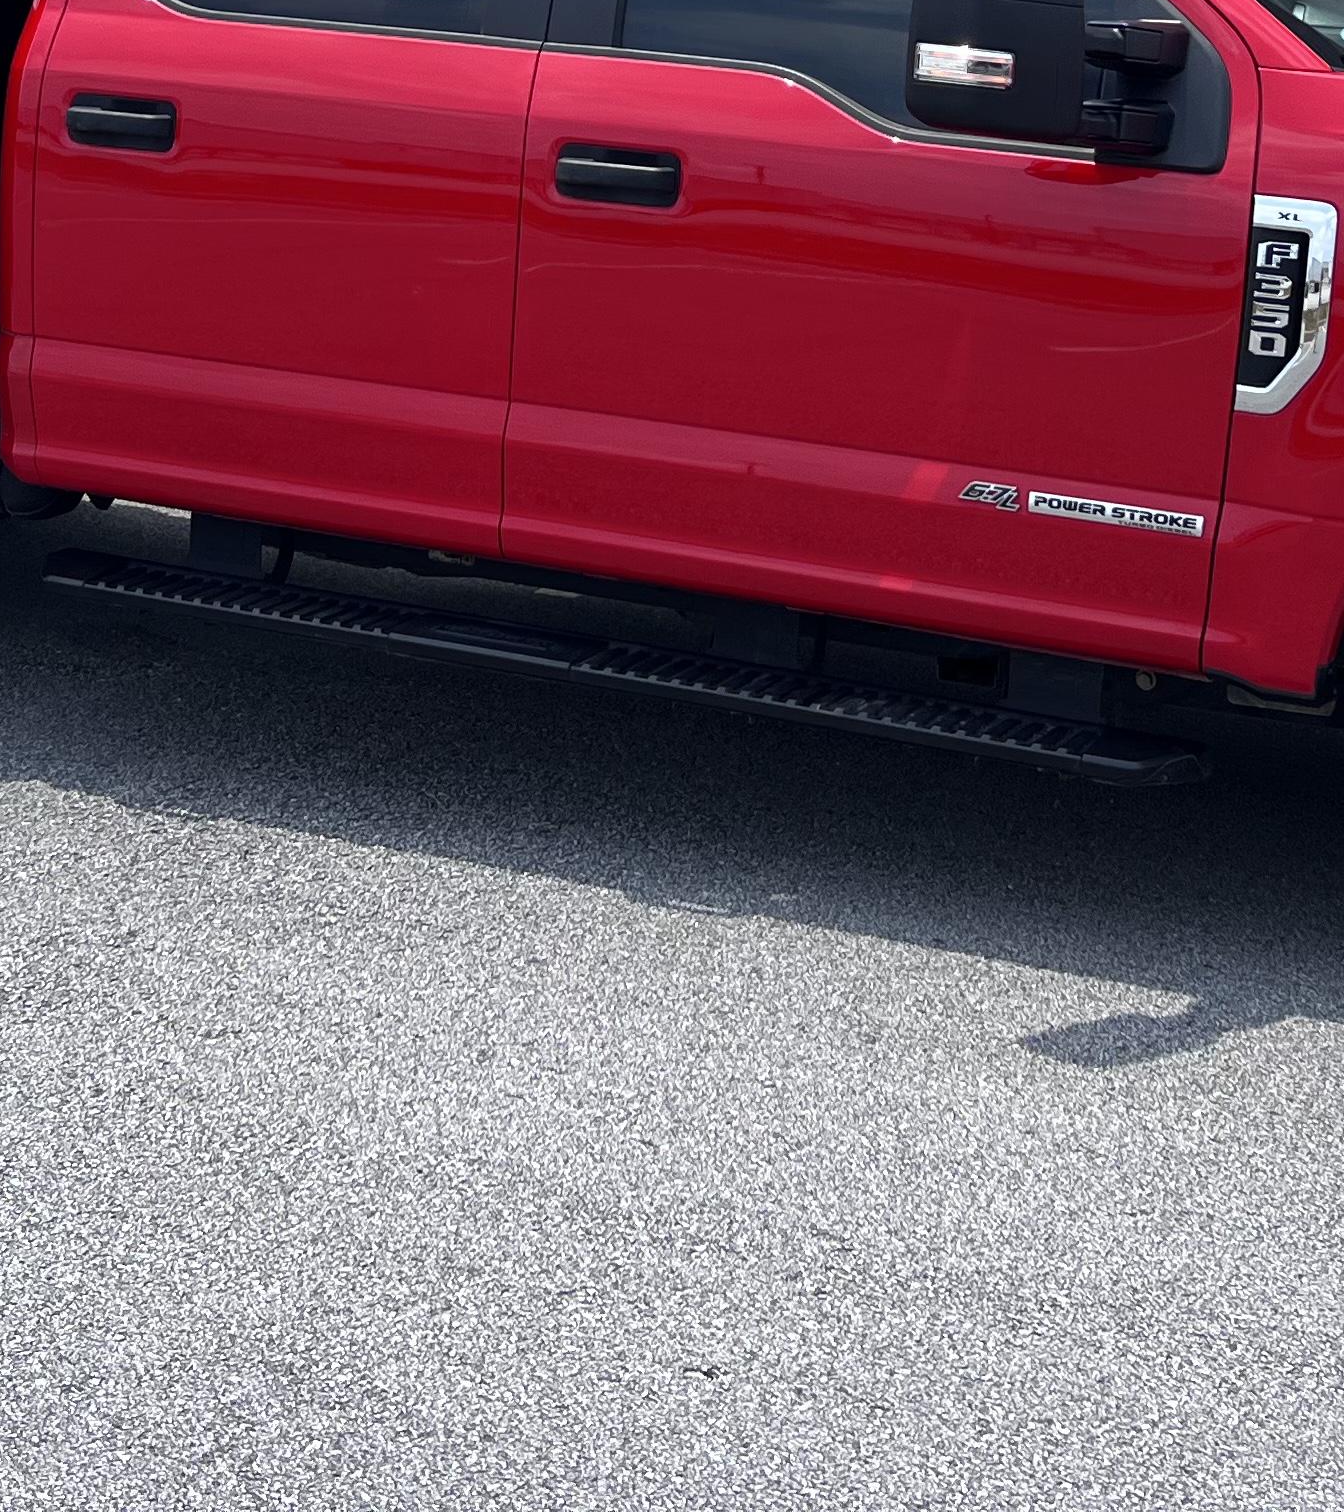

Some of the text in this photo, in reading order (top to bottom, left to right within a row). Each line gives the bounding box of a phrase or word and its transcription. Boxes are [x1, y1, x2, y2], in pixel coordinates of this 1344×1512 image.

[1277, 211, 1303, 222] XL
[1248, 240, 1299, 358] F350
[1034, 495, 1106, 516] POWER
[1111, 506, 1197, 530] STROKE
